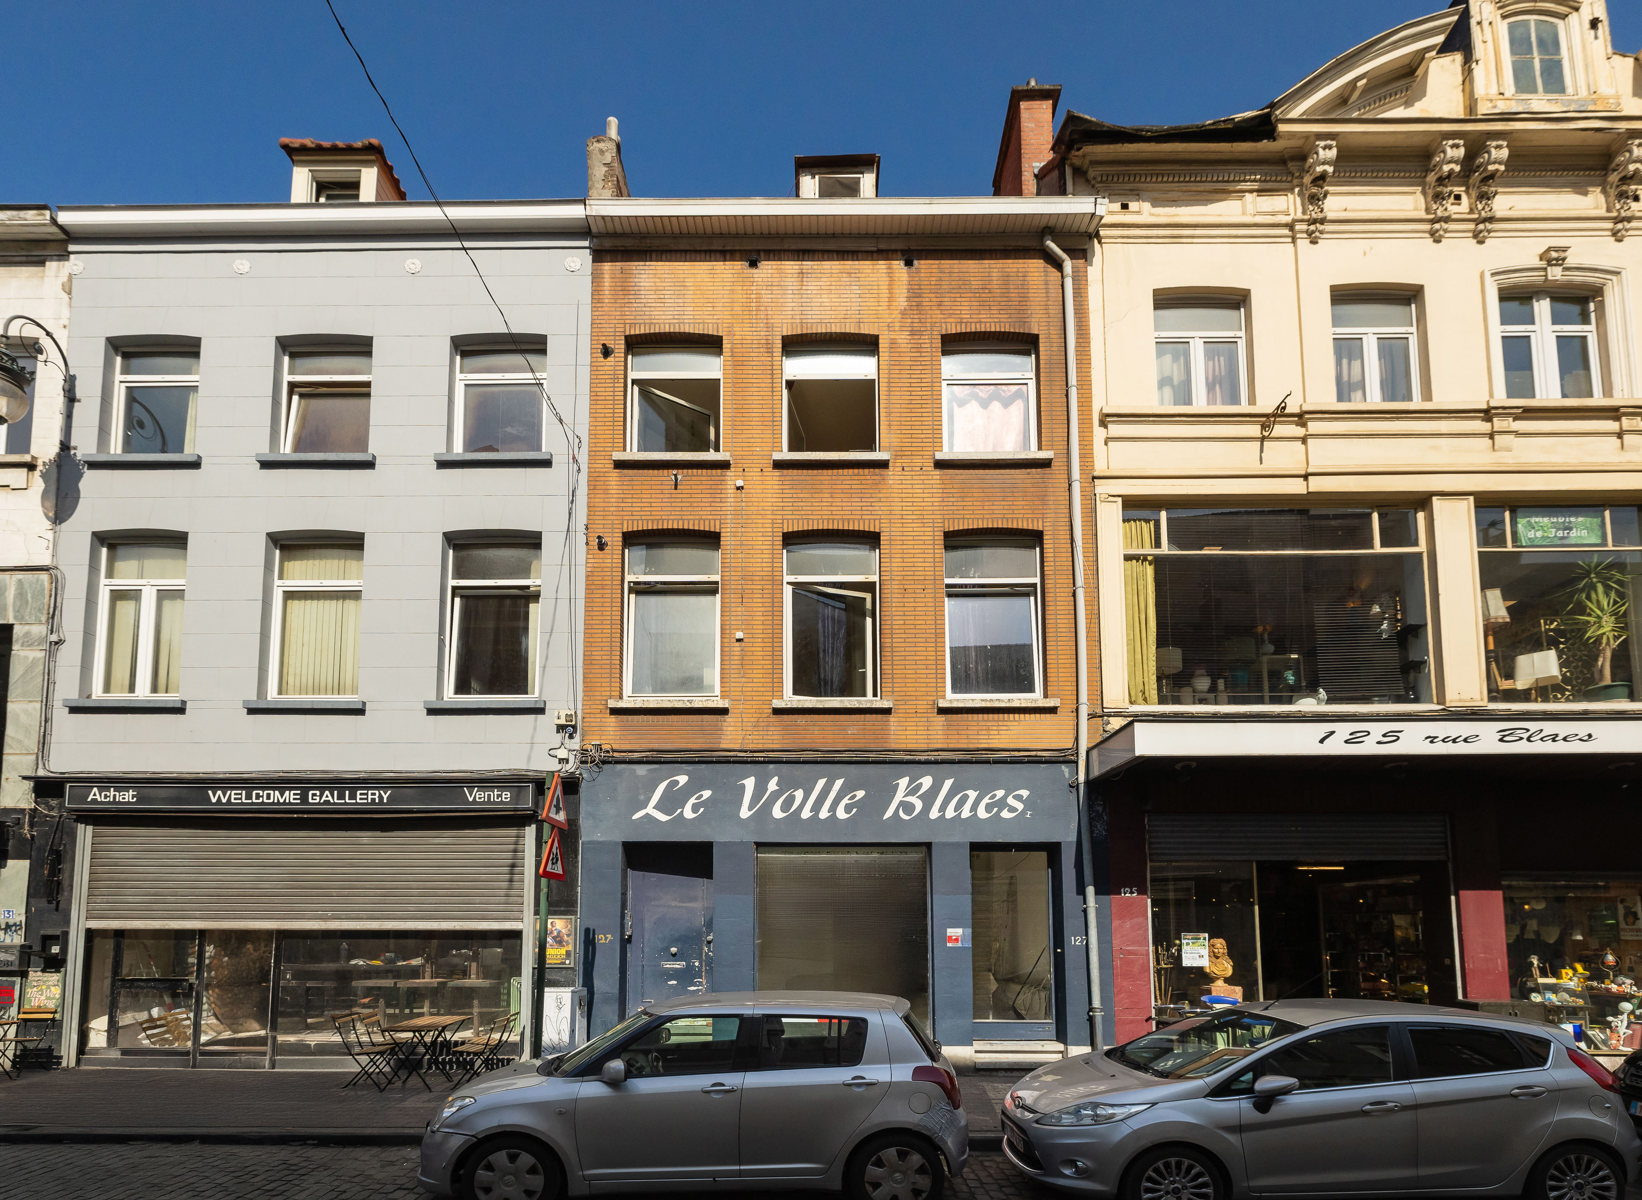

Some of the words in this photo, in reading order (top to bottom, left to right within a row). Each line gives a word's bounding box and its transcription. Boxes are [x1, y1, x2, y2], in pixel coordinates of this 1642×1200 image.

[1527, 528, 1542, 538] de
[1548, 527, 1588, 537] Jardin
[1318, 729, 1404, 745] 125
[1422, 733, 1482, 744] rue
[1496, 727, 1598, 743] Blaes
[87, 787, 137, 802] Achat
[208, 790, 300, 803] WELCOME
[308, 790, 391, 803] GALLERY
[464, 787, 510, 802] Vente
[631, 774, 713, 822] Le
[736, 775, 866, 820] Volle
[882, 775, 1031, 821] Blaes
[1121, 887, 1138, 897] 125
[3, 910, 15, 919] 131
[1071, 936, 1088, 945] 127
